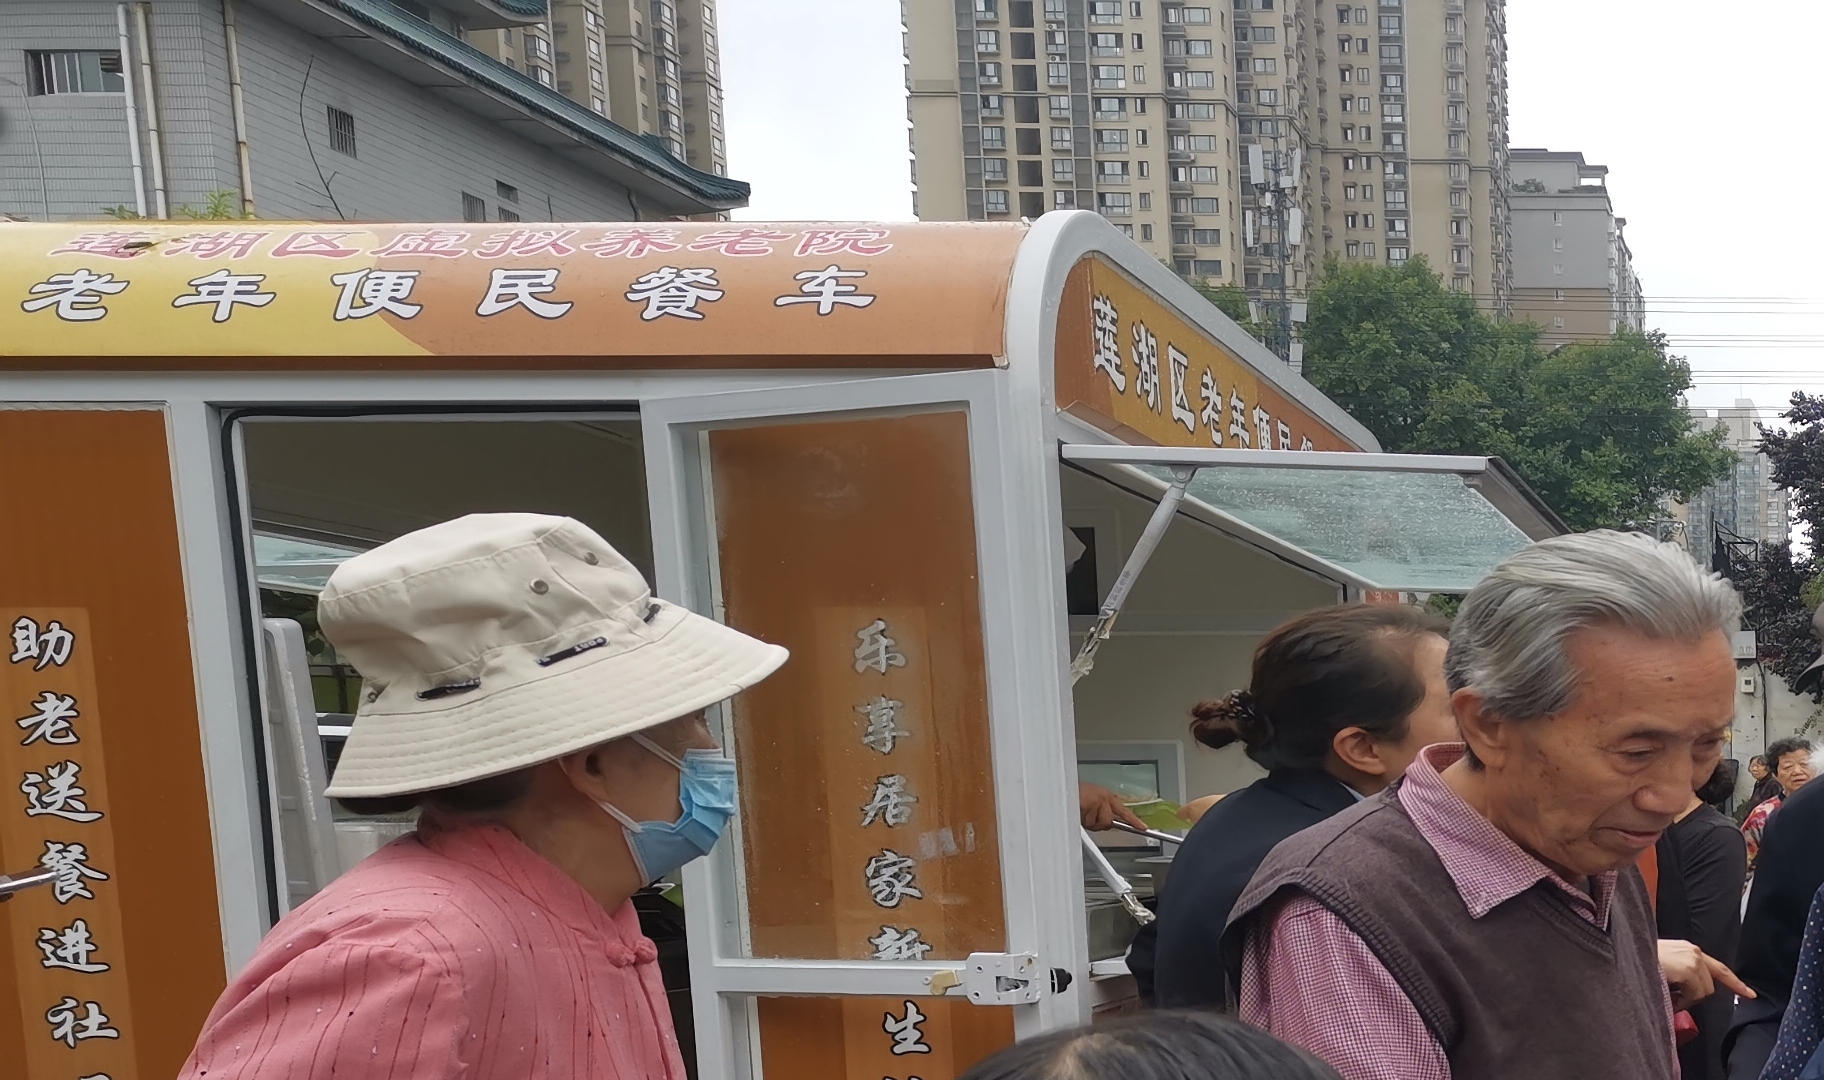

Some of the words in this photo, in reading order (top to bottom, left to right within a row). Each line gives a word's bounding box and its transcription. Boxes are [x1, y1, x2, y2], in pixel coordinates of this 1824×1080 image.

[22, 262, 877, 323] 老年便民餐车
